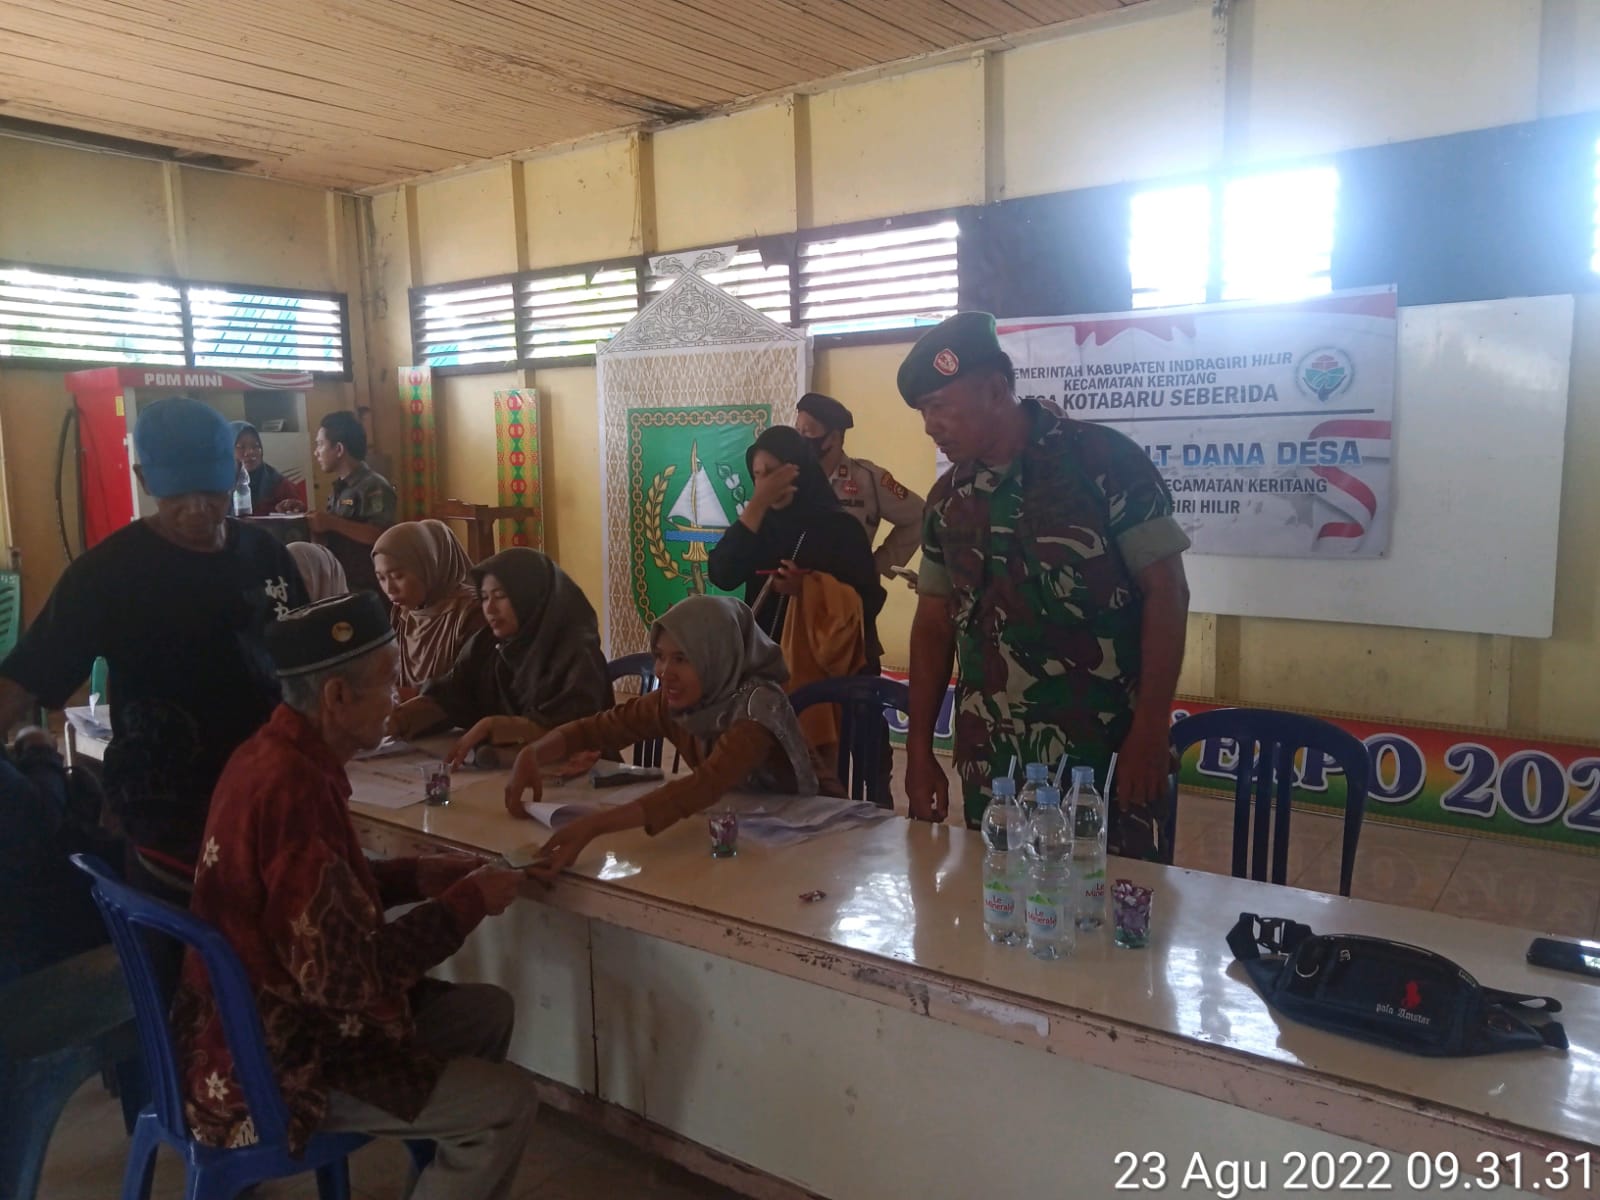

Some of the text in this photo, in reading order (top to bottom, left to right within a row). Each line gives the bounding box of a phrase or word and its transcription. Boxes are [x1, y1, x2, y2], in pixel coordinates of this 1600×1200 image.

[1013, 351, 1293, 380] EMERINTAH KABUPATEN INDRAGIRI HILIR
[143, 372, 223, 388] POM MINI
[1063, 372, 1217, 392] KECAMATAN KERITANG
[1063, 383, 1279, 411] KOTABARU SEBERIDA
[1182, 441, 1265, 467] DANA
[1277, 440, 1361, 465] DESA
[1165, 478, 1328, 493] ECAMATAN KERITANG
[1171, 499, 1241, 514] GIRI HILIR
